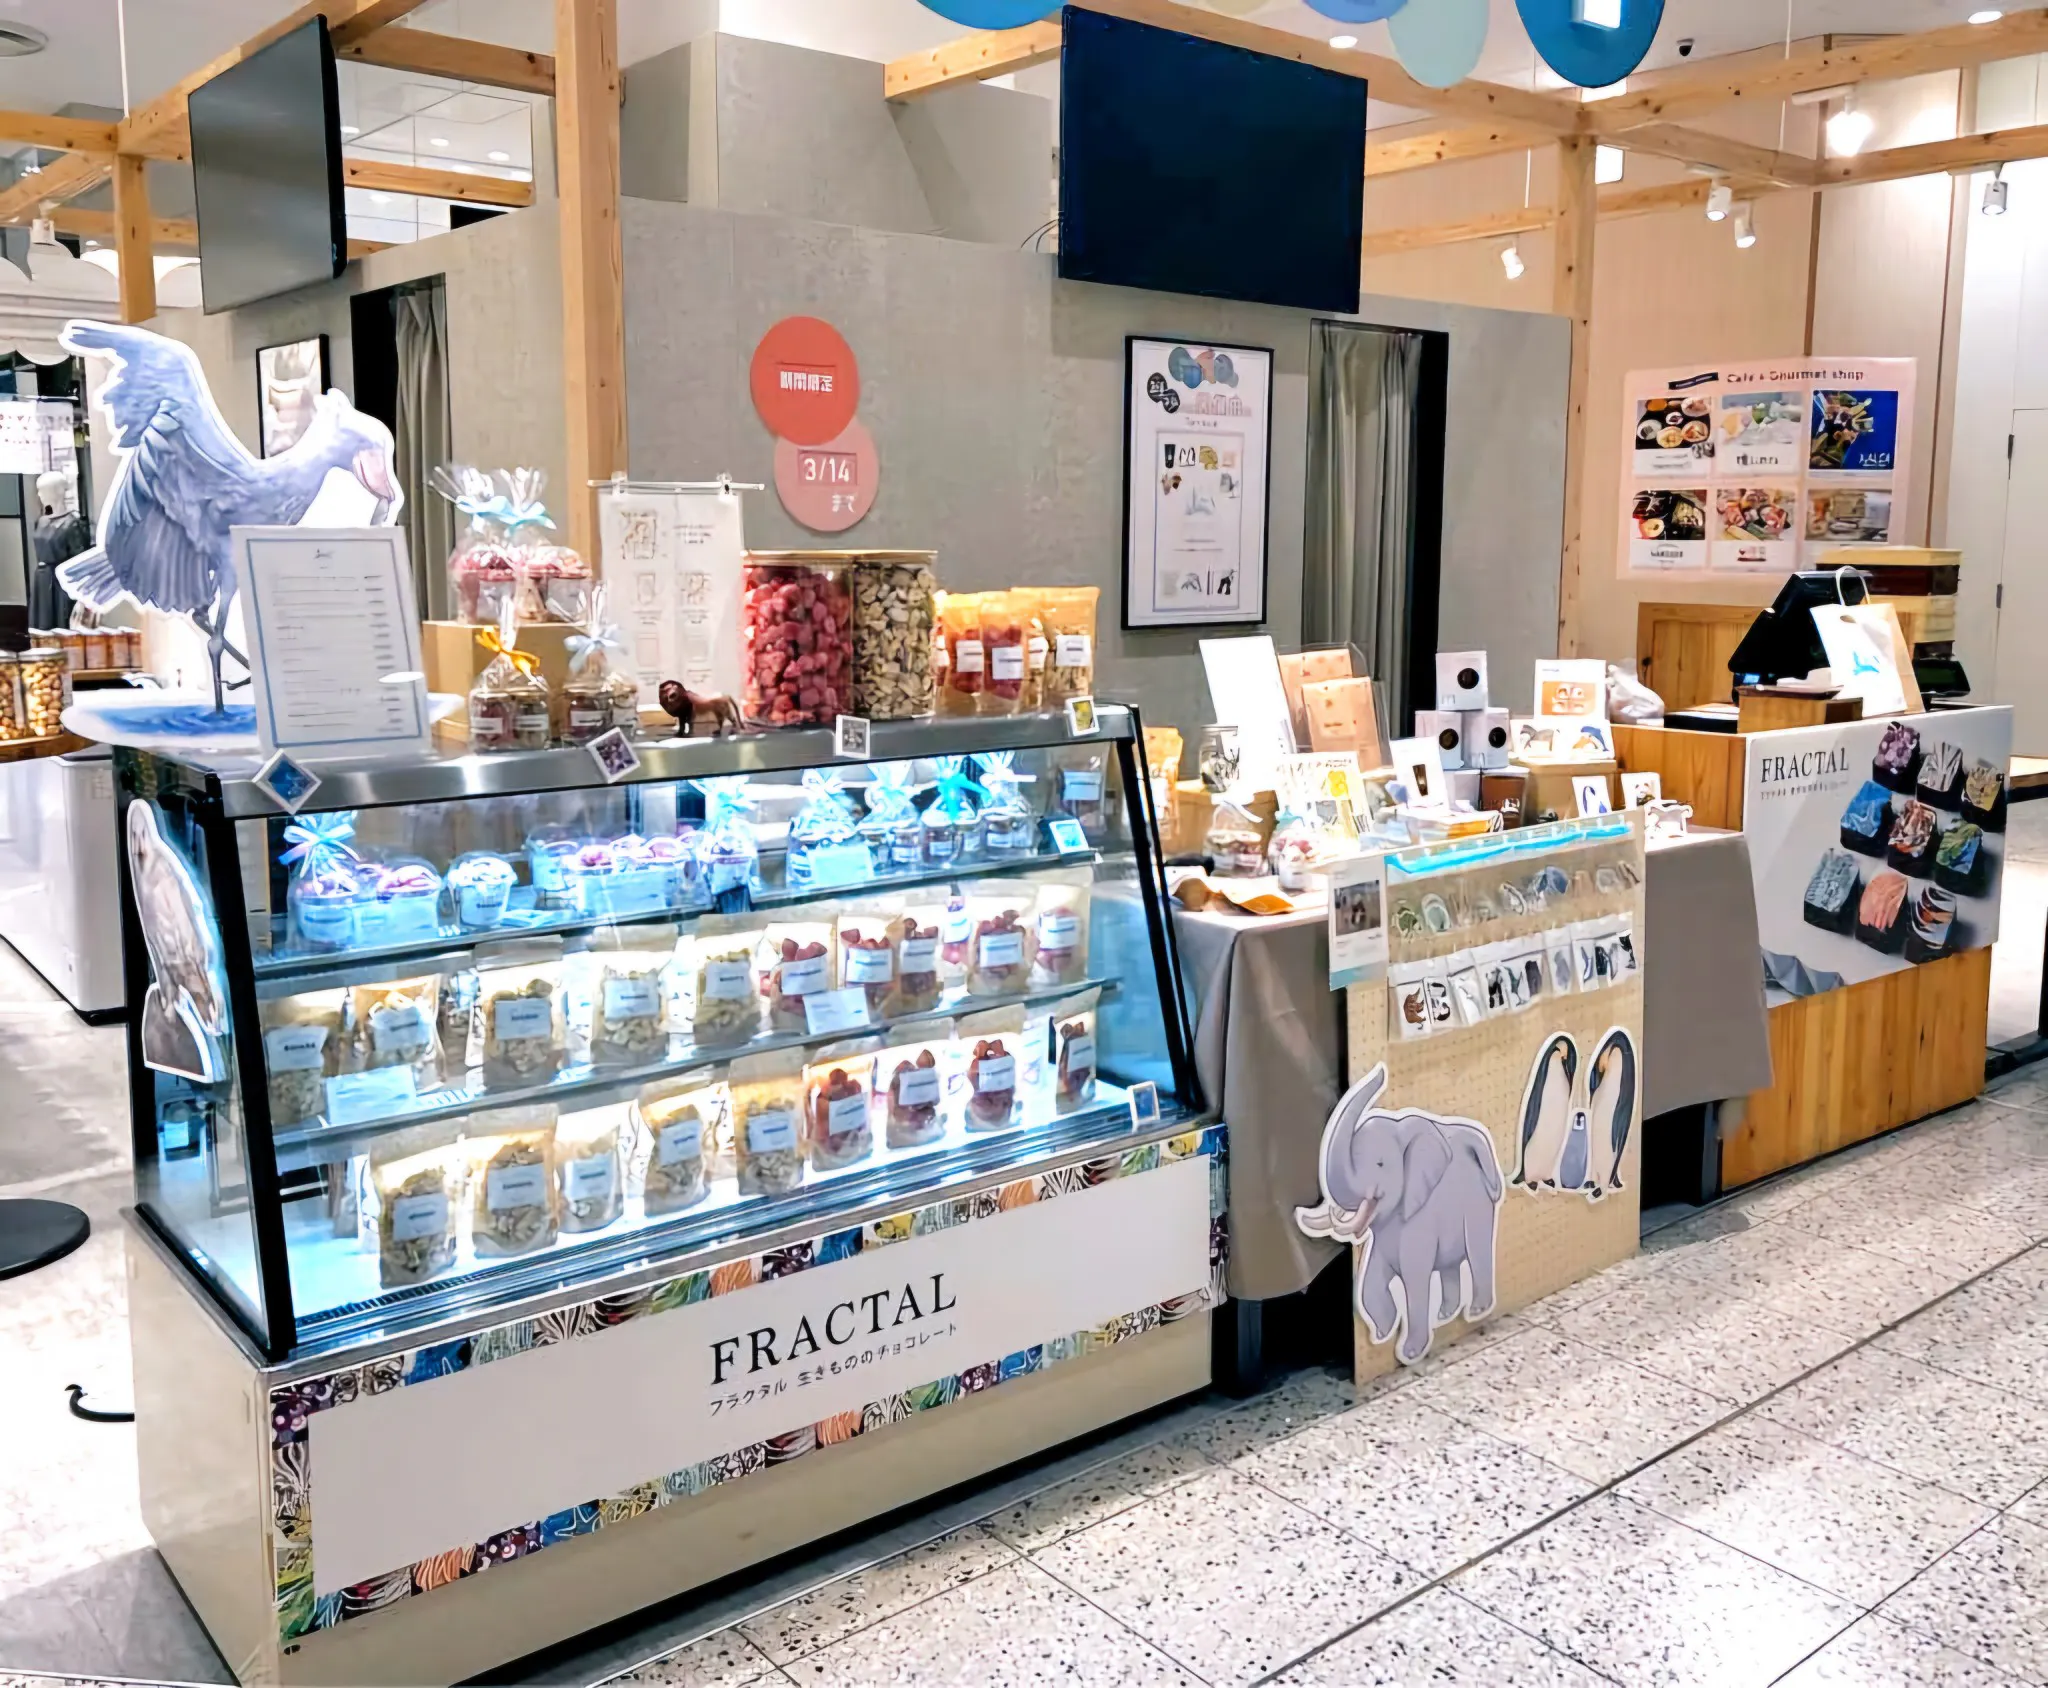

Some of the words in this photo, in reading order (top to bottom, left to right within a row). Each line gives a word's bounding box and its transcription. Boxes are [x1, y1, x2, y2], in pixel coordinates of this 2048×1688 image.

[803, 456, 850, 483] 3/14
[1761, 747, 1849, 783] FRACTAL
[709, 1272, 957, 1386] FRACTAL
[710, 1378, 788, 1417] フラクタル
[797, 1322, 957, 1388] 生きもののチョコレート
